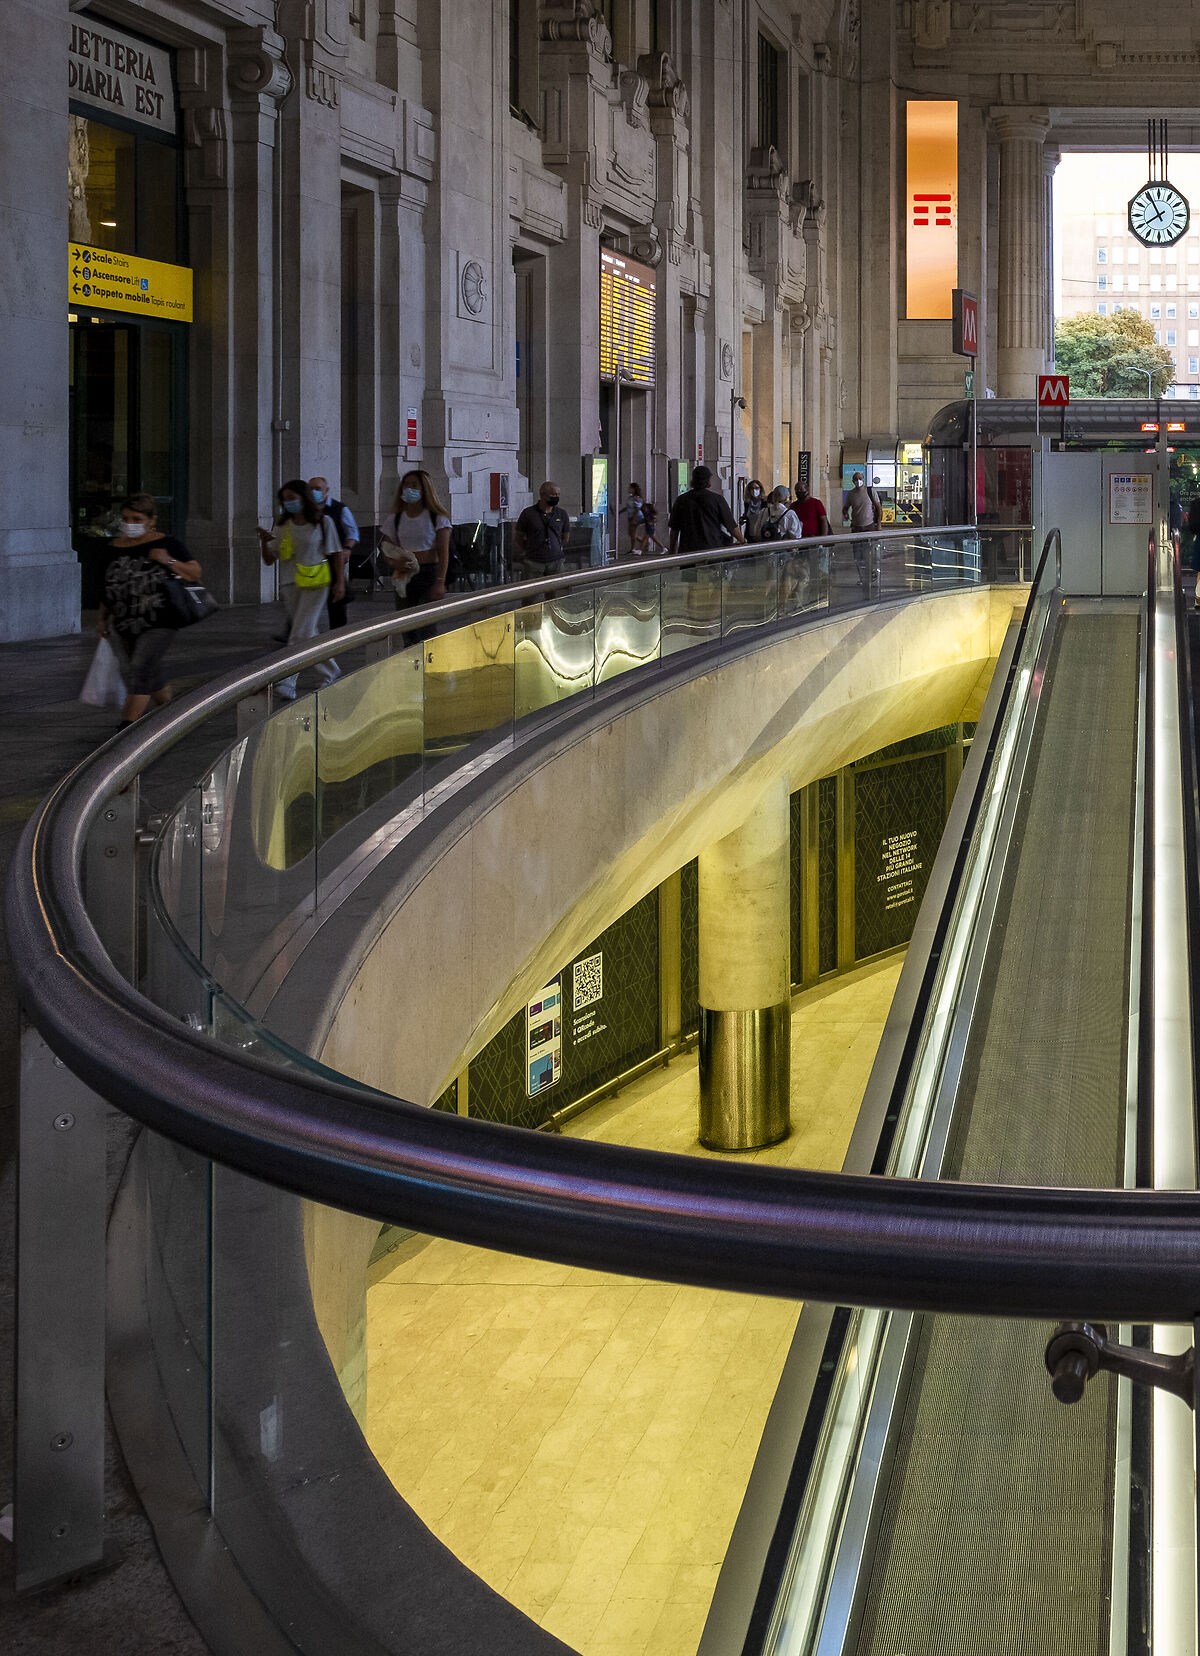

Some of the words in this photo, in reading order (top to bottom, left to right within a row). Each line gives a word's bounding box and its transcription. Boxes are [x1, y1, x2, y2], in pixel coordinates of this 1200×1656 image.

[135, 84, 164, 120] EST
[92, 252, 112, 264] Scale
[112, 256, 129, 268] Stairs
[92, 269, 131, 284] Ascensore
[131, 276, 139, 286] Lift
[92, 285, 123, 299] Tappeto
[125, 292, 150, 304] mobile
[151, 296, 165, 307] Tapis
[166, 300, 185, 310] roulant
[964, 307, 977, 343] M
[1040, 380, 1067, 400] M
[800, 454, 808, 484] GUESS
[888, 836, 899, 844] TUO
[900, 831, 918, 840] NUOVO
[889, 840, 911, 850] NEGOZIO
[882, 852, 892, 860] NEL
[893, 844, 918, 856] NETWORK
[889, 855, 905, 864] DELLE
[877, 869, 900, 882] STAZIONI
[900, 862, 922, 875] ITALIANE
[895, 858, 914, 869] GRANDI
